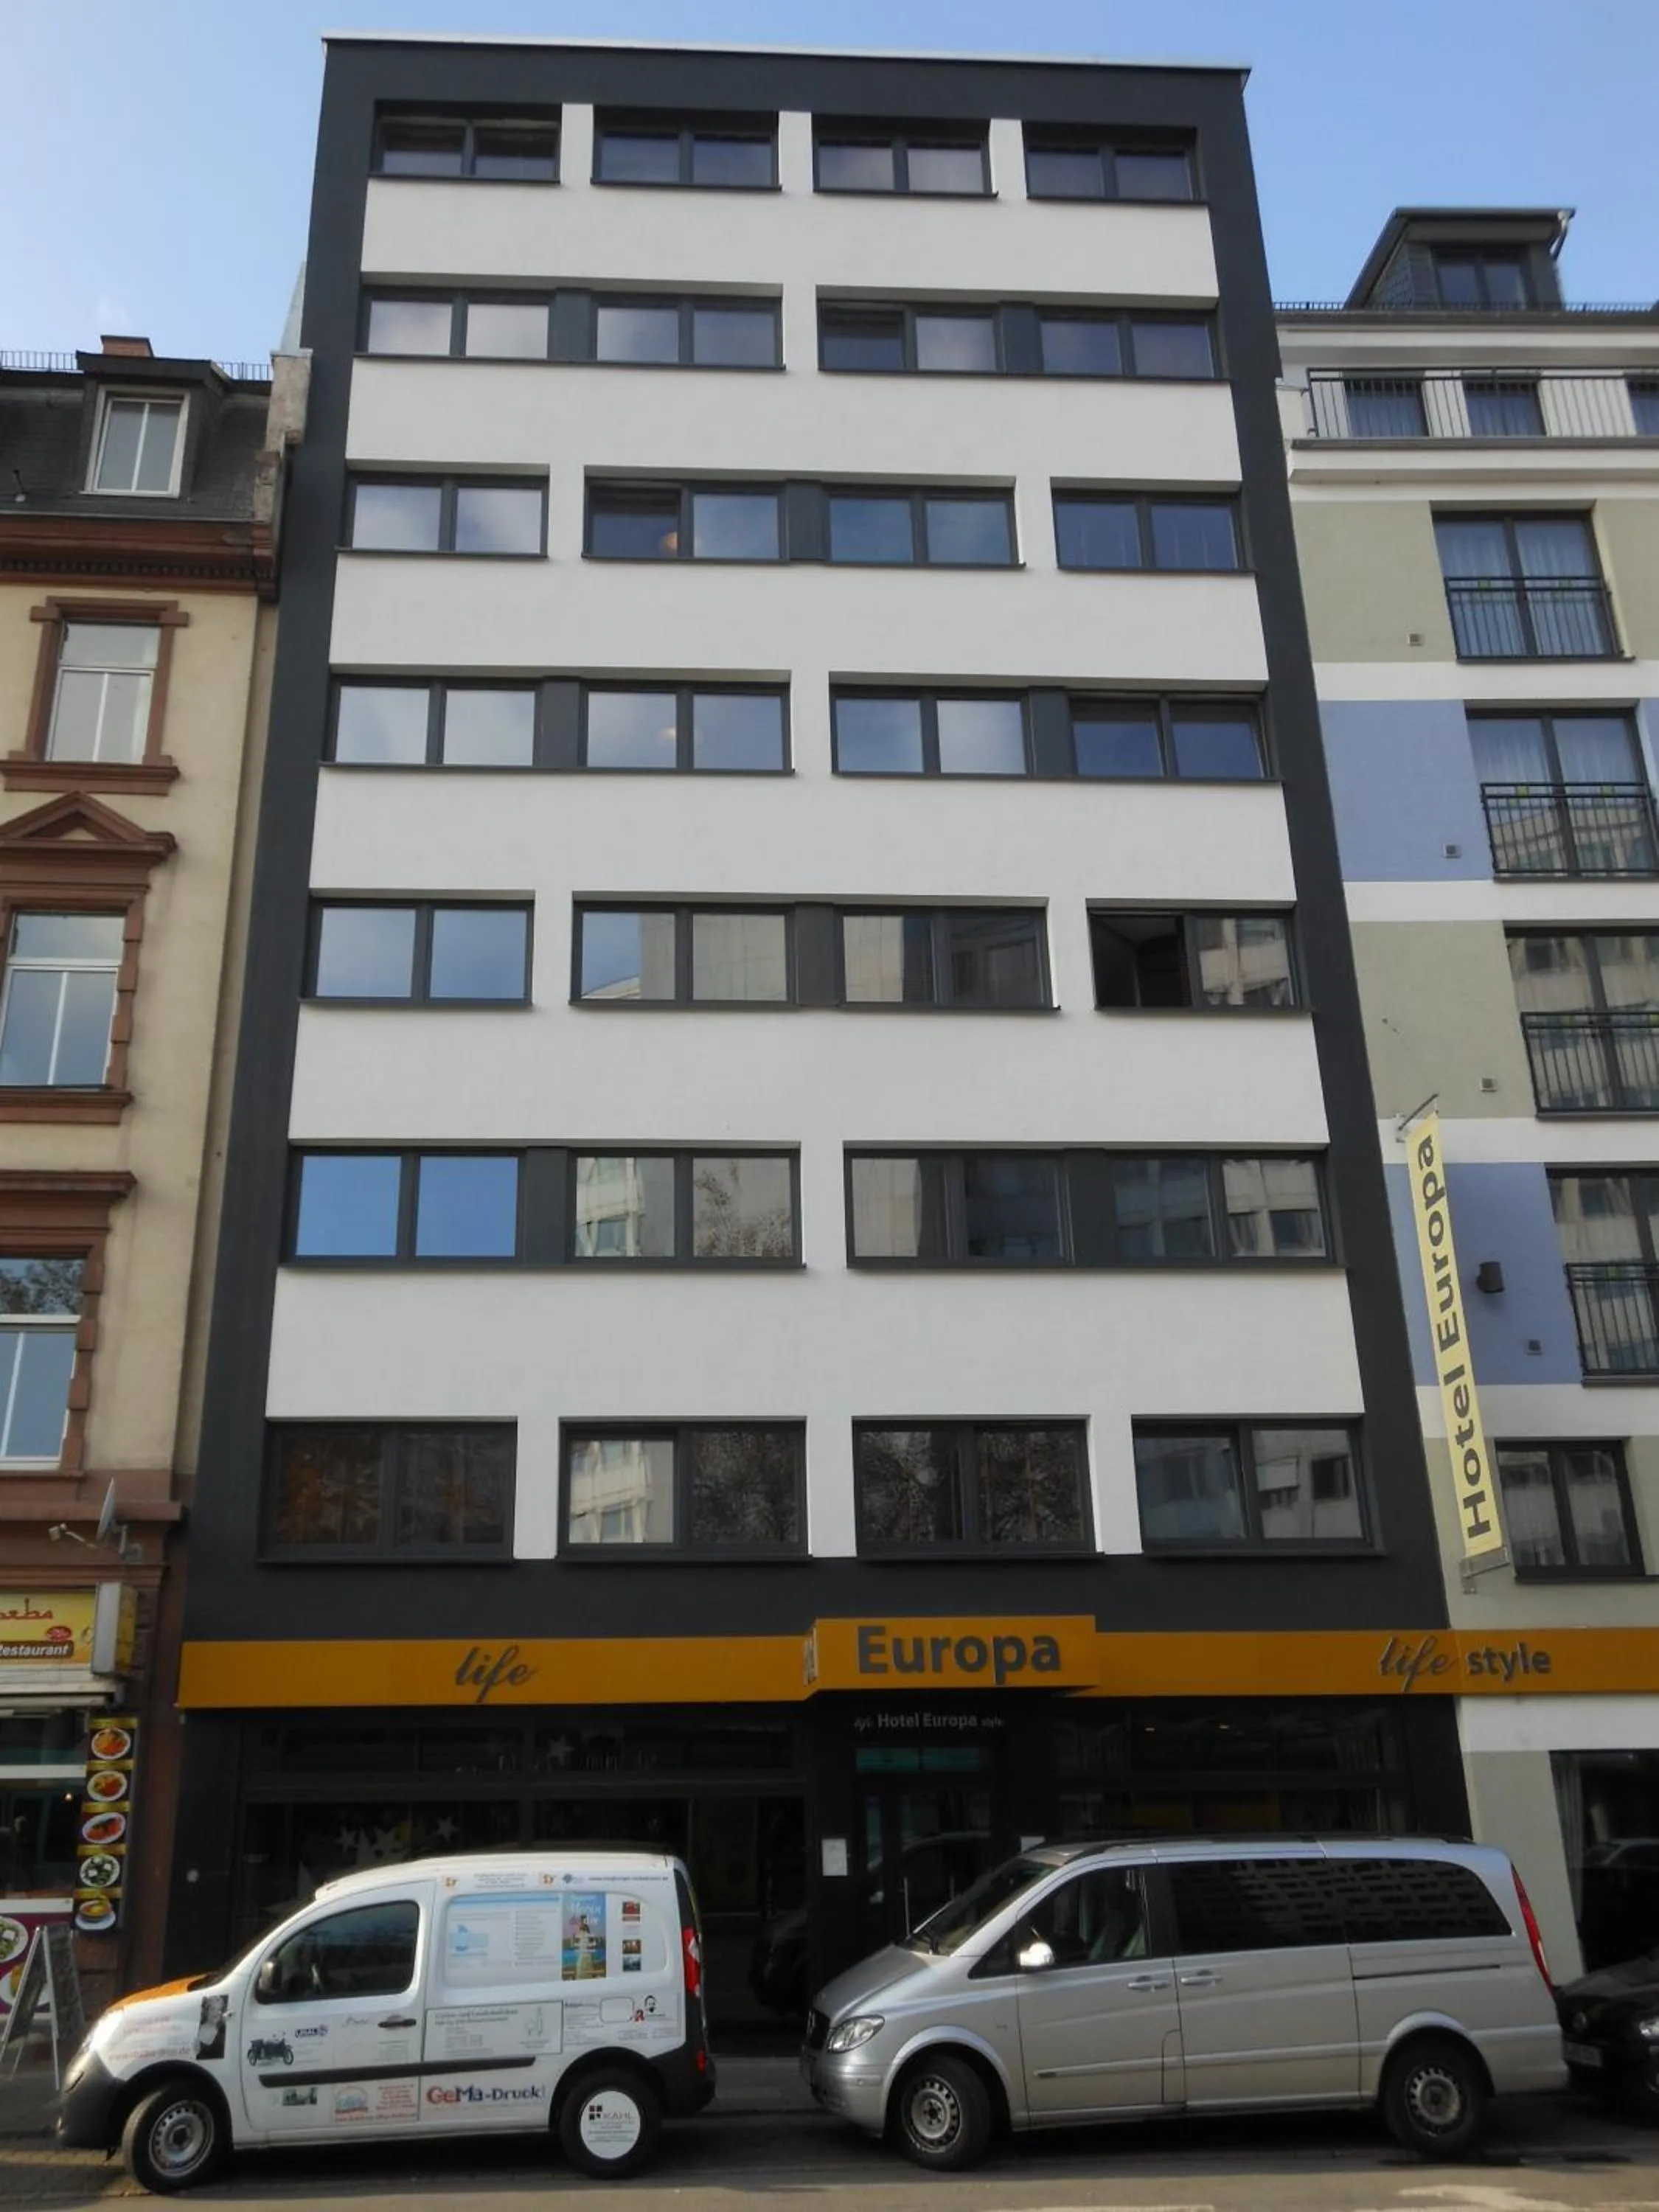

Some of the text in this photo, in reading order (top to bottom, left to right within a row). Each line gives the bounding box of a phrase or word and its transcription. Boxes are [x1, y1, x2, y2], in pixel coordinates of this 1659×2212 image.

[1418, 1134, 1491, 1539] Hotel Europa
[0, 1644, 69, 1656] estaurant
[455, 1645, 539, 1704] life
[858, 1625, 1062, 1686] Europa
[1379, 1635, 1551, 1693] life style
[877, 1712, 919, 1728] Hotel
[923, 1712, 978, 1731] Europa
